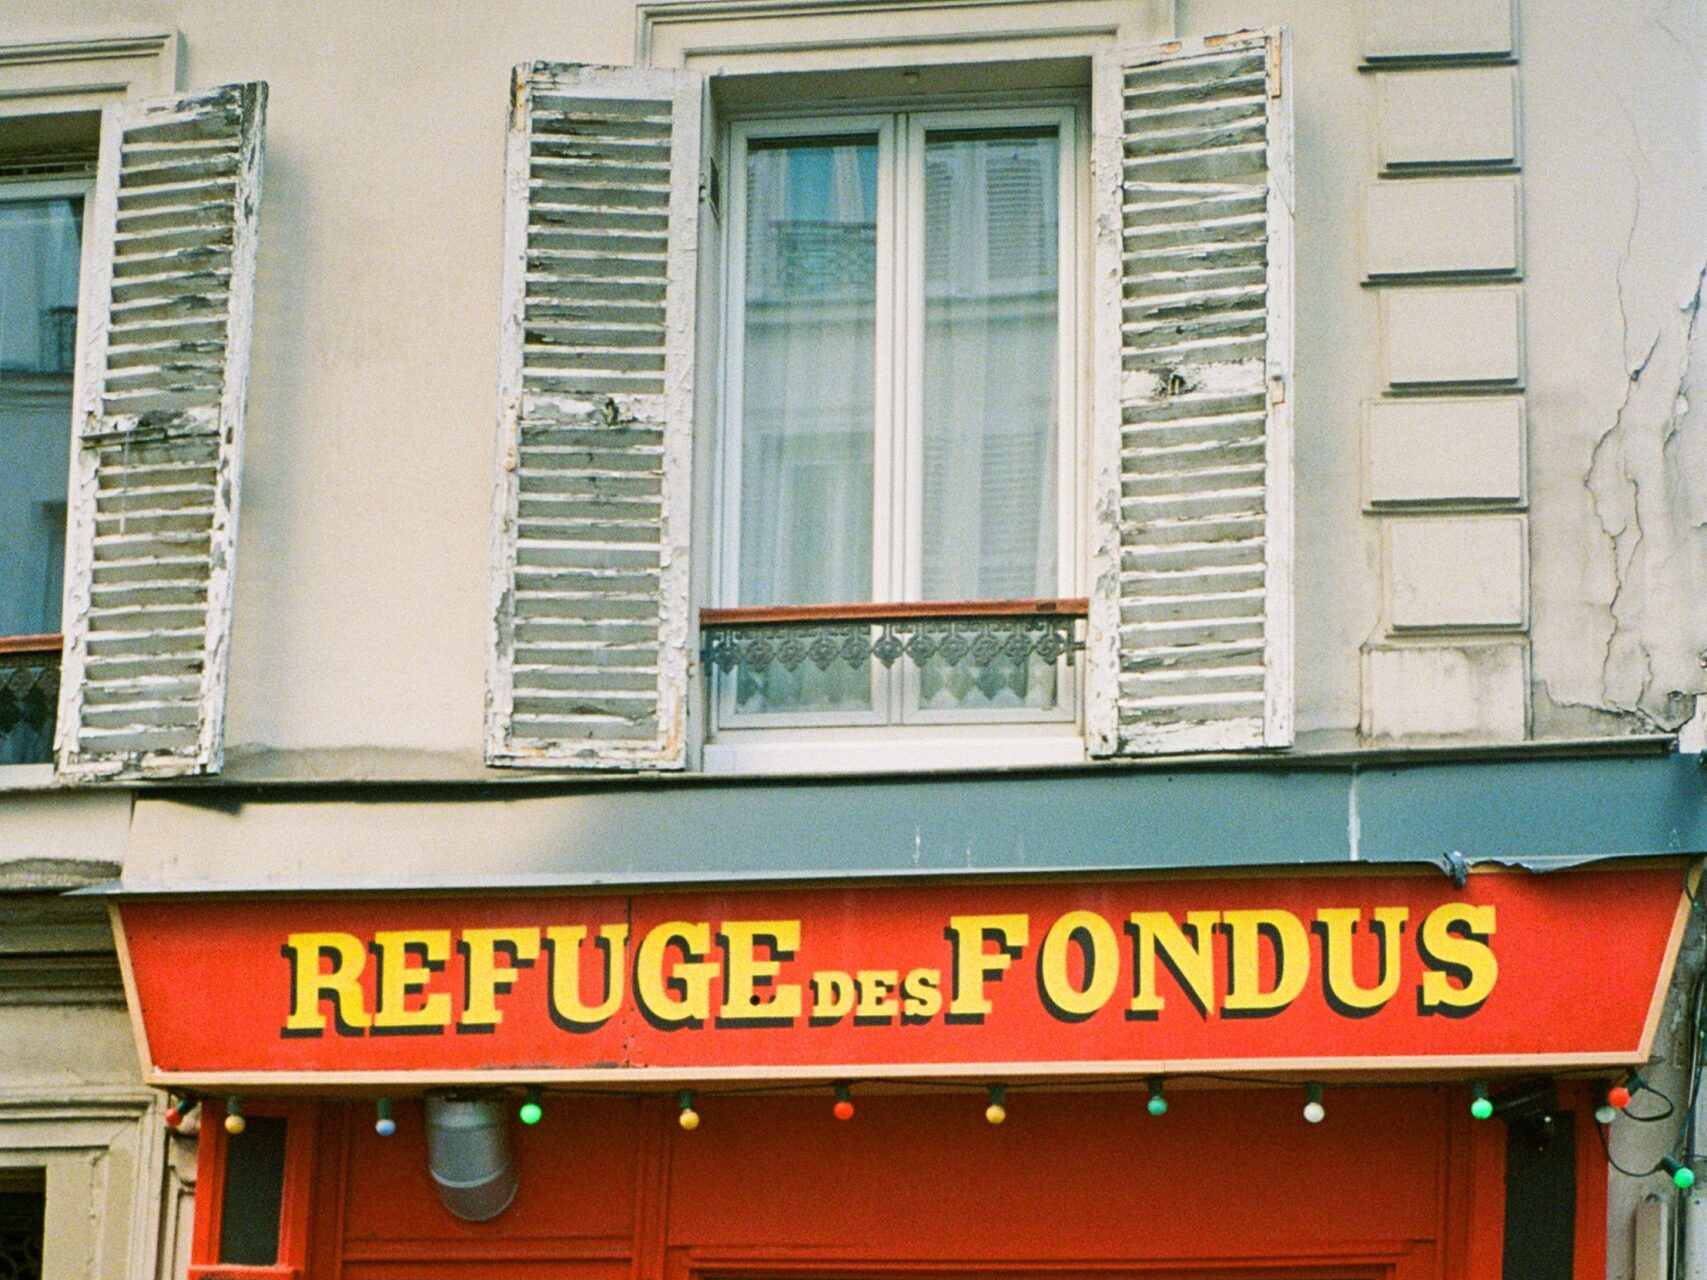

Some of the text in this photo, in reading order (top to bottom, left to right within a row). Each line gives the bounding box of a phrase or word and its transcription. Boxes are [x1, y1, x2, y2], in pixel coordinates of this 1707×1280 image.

[281, 903, 1498, 1038] REFUGE DES FONDUS
